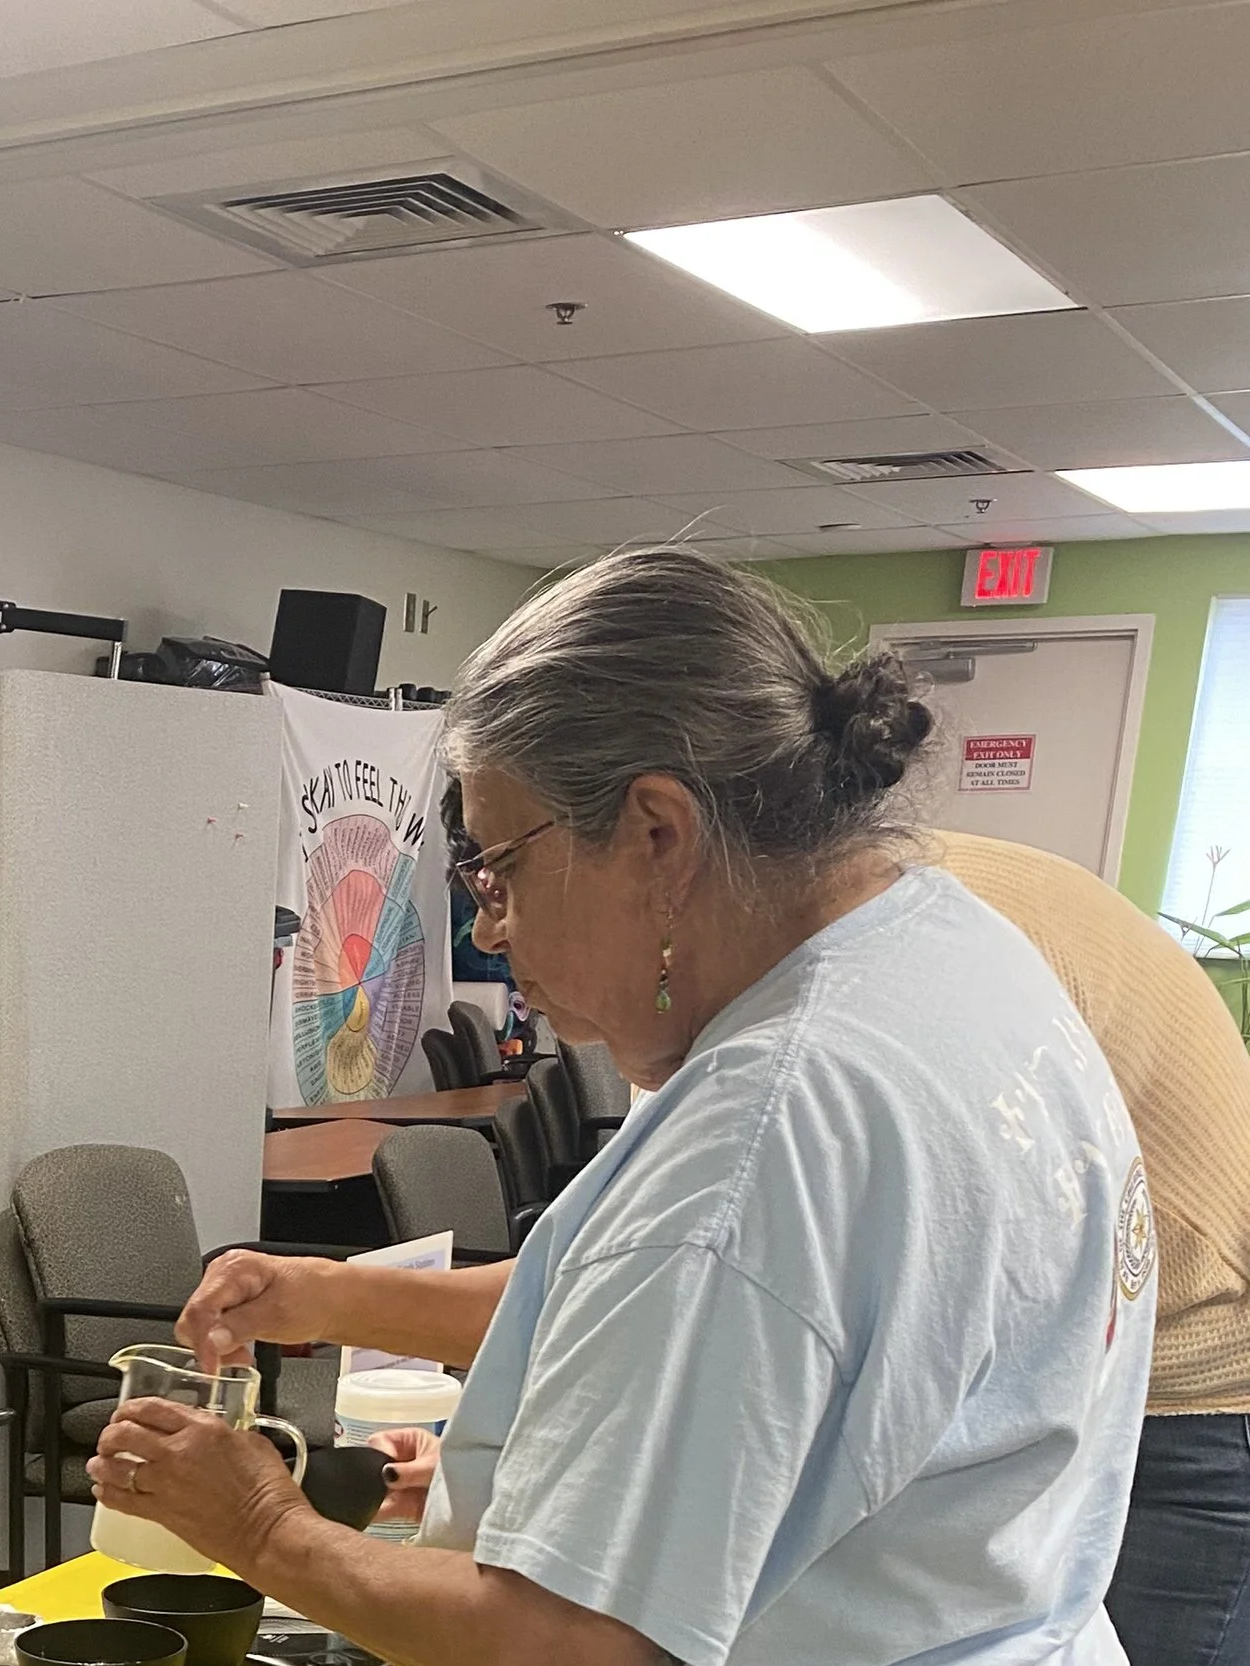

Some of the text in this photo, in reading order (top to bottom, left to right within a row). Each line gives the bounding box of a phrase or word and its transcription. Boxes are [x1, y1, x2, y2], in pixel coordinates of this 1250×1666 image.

[976, 549, 1040, 599] EXIT
[970, 739, 1027, 749] EMERGENCY
[973, 750, 1022, 759] EXIT ONLY
[334, 759, 353, 801] TO
[355, 759, 384, 807] FEEL
[997, 778, 1020, 786] TIMES
